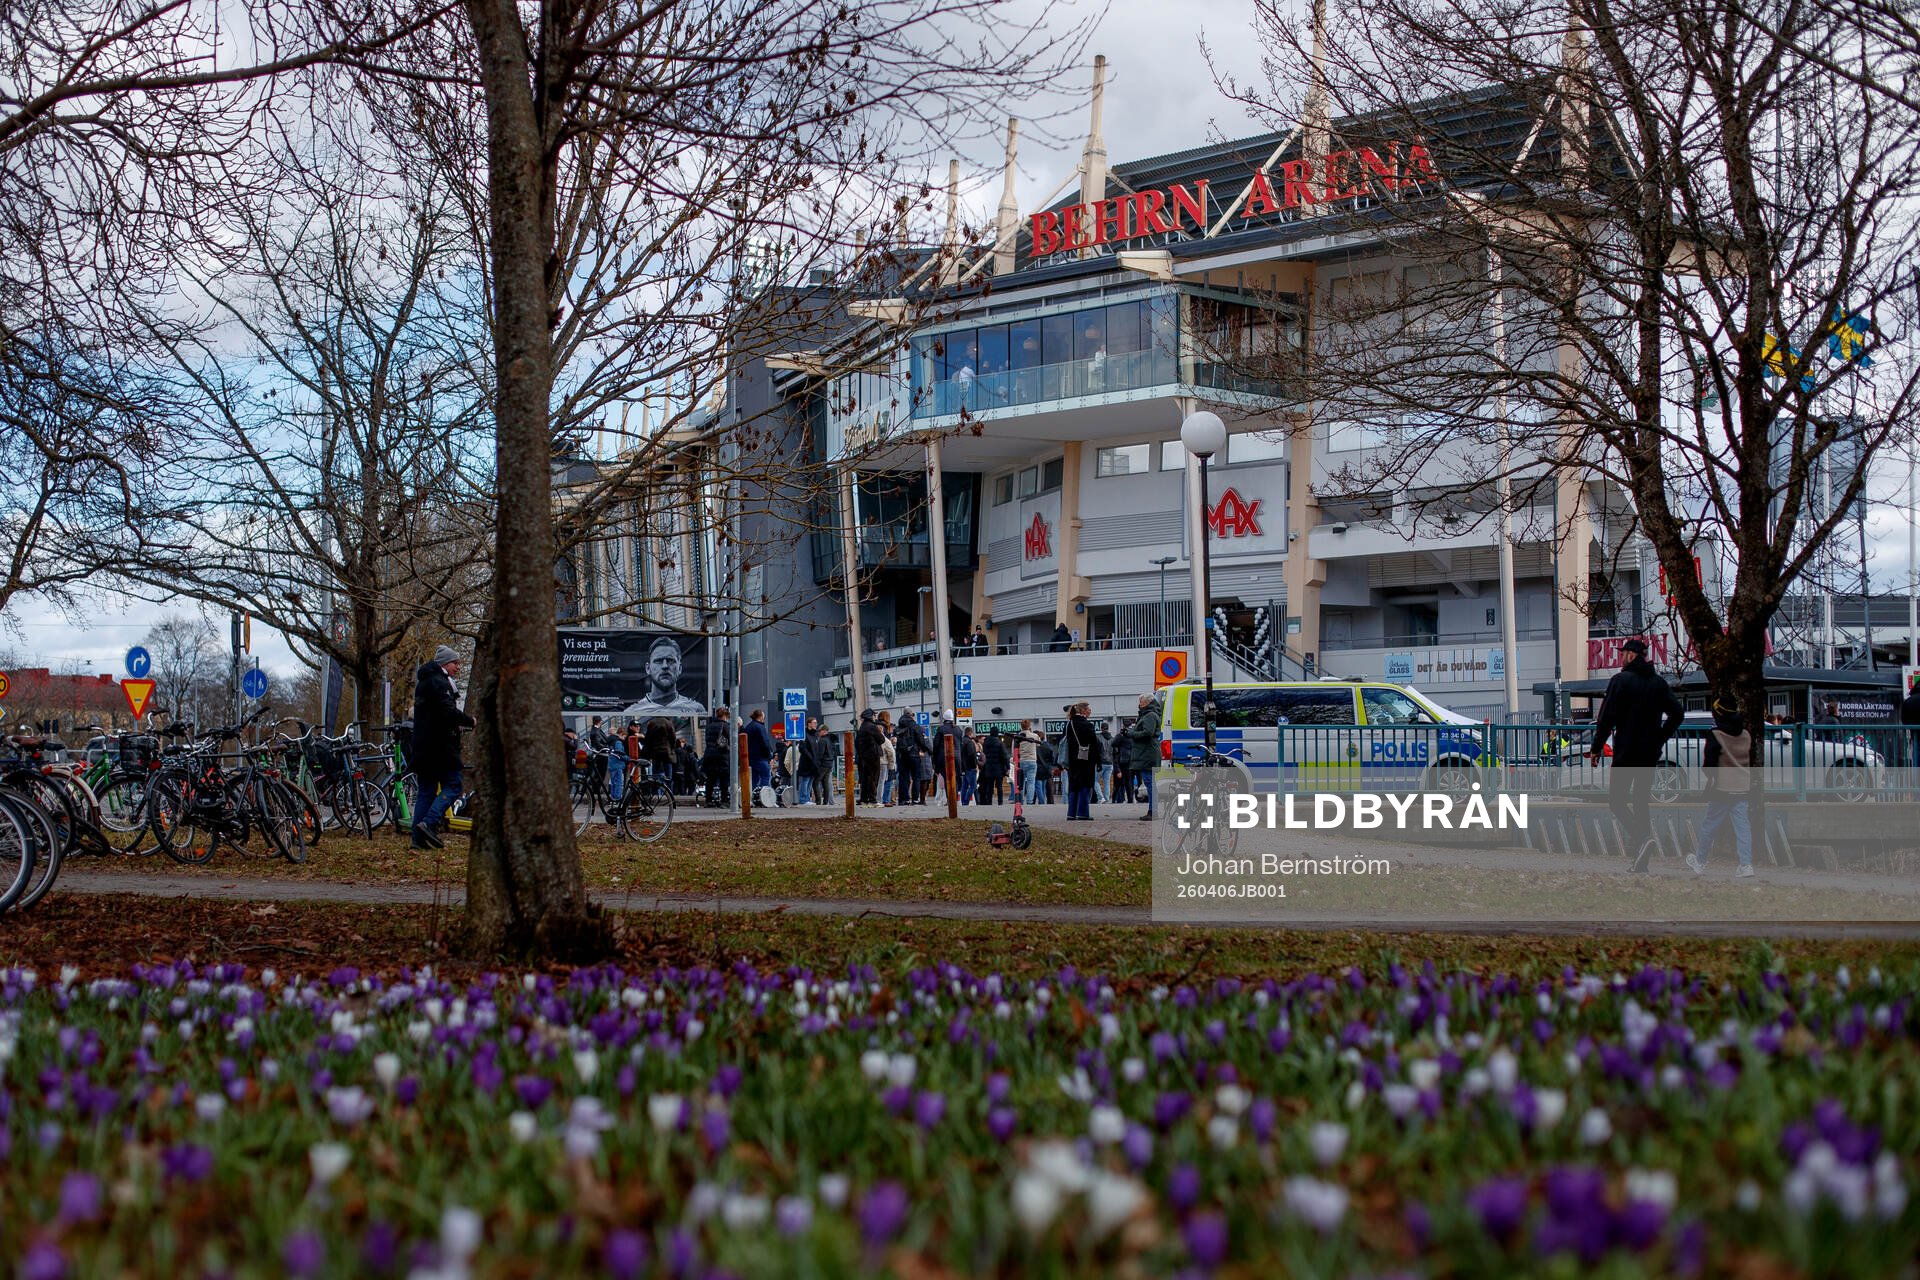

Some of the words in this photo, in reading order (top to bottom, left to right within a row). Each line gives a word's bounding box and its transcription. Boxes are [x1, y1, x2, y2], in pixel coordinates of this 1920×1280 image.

[1028, 179, 1209, 257] BEHRN
[1240, 134, 1441, 217] ARENA
[1025, 511, 1049, 561] MAX
[563, 638, 574, 648] Vi
[594, 638, 607, 651] på
[562, 651, 609, 664] premiären
[1389, 666, 1410, 674] GLASS
[1417, 664, 1433, 673] DET
[1436, 661, 1448, 672] ÄR
[1450, 663, 1462, 671] DU
[960, 676, 970, 689] P
[1863, 702, 1894, 710] LÄKTAREN
[920, 713, 928, 725] P
[1371, 742, 1428, 759] POLIS
